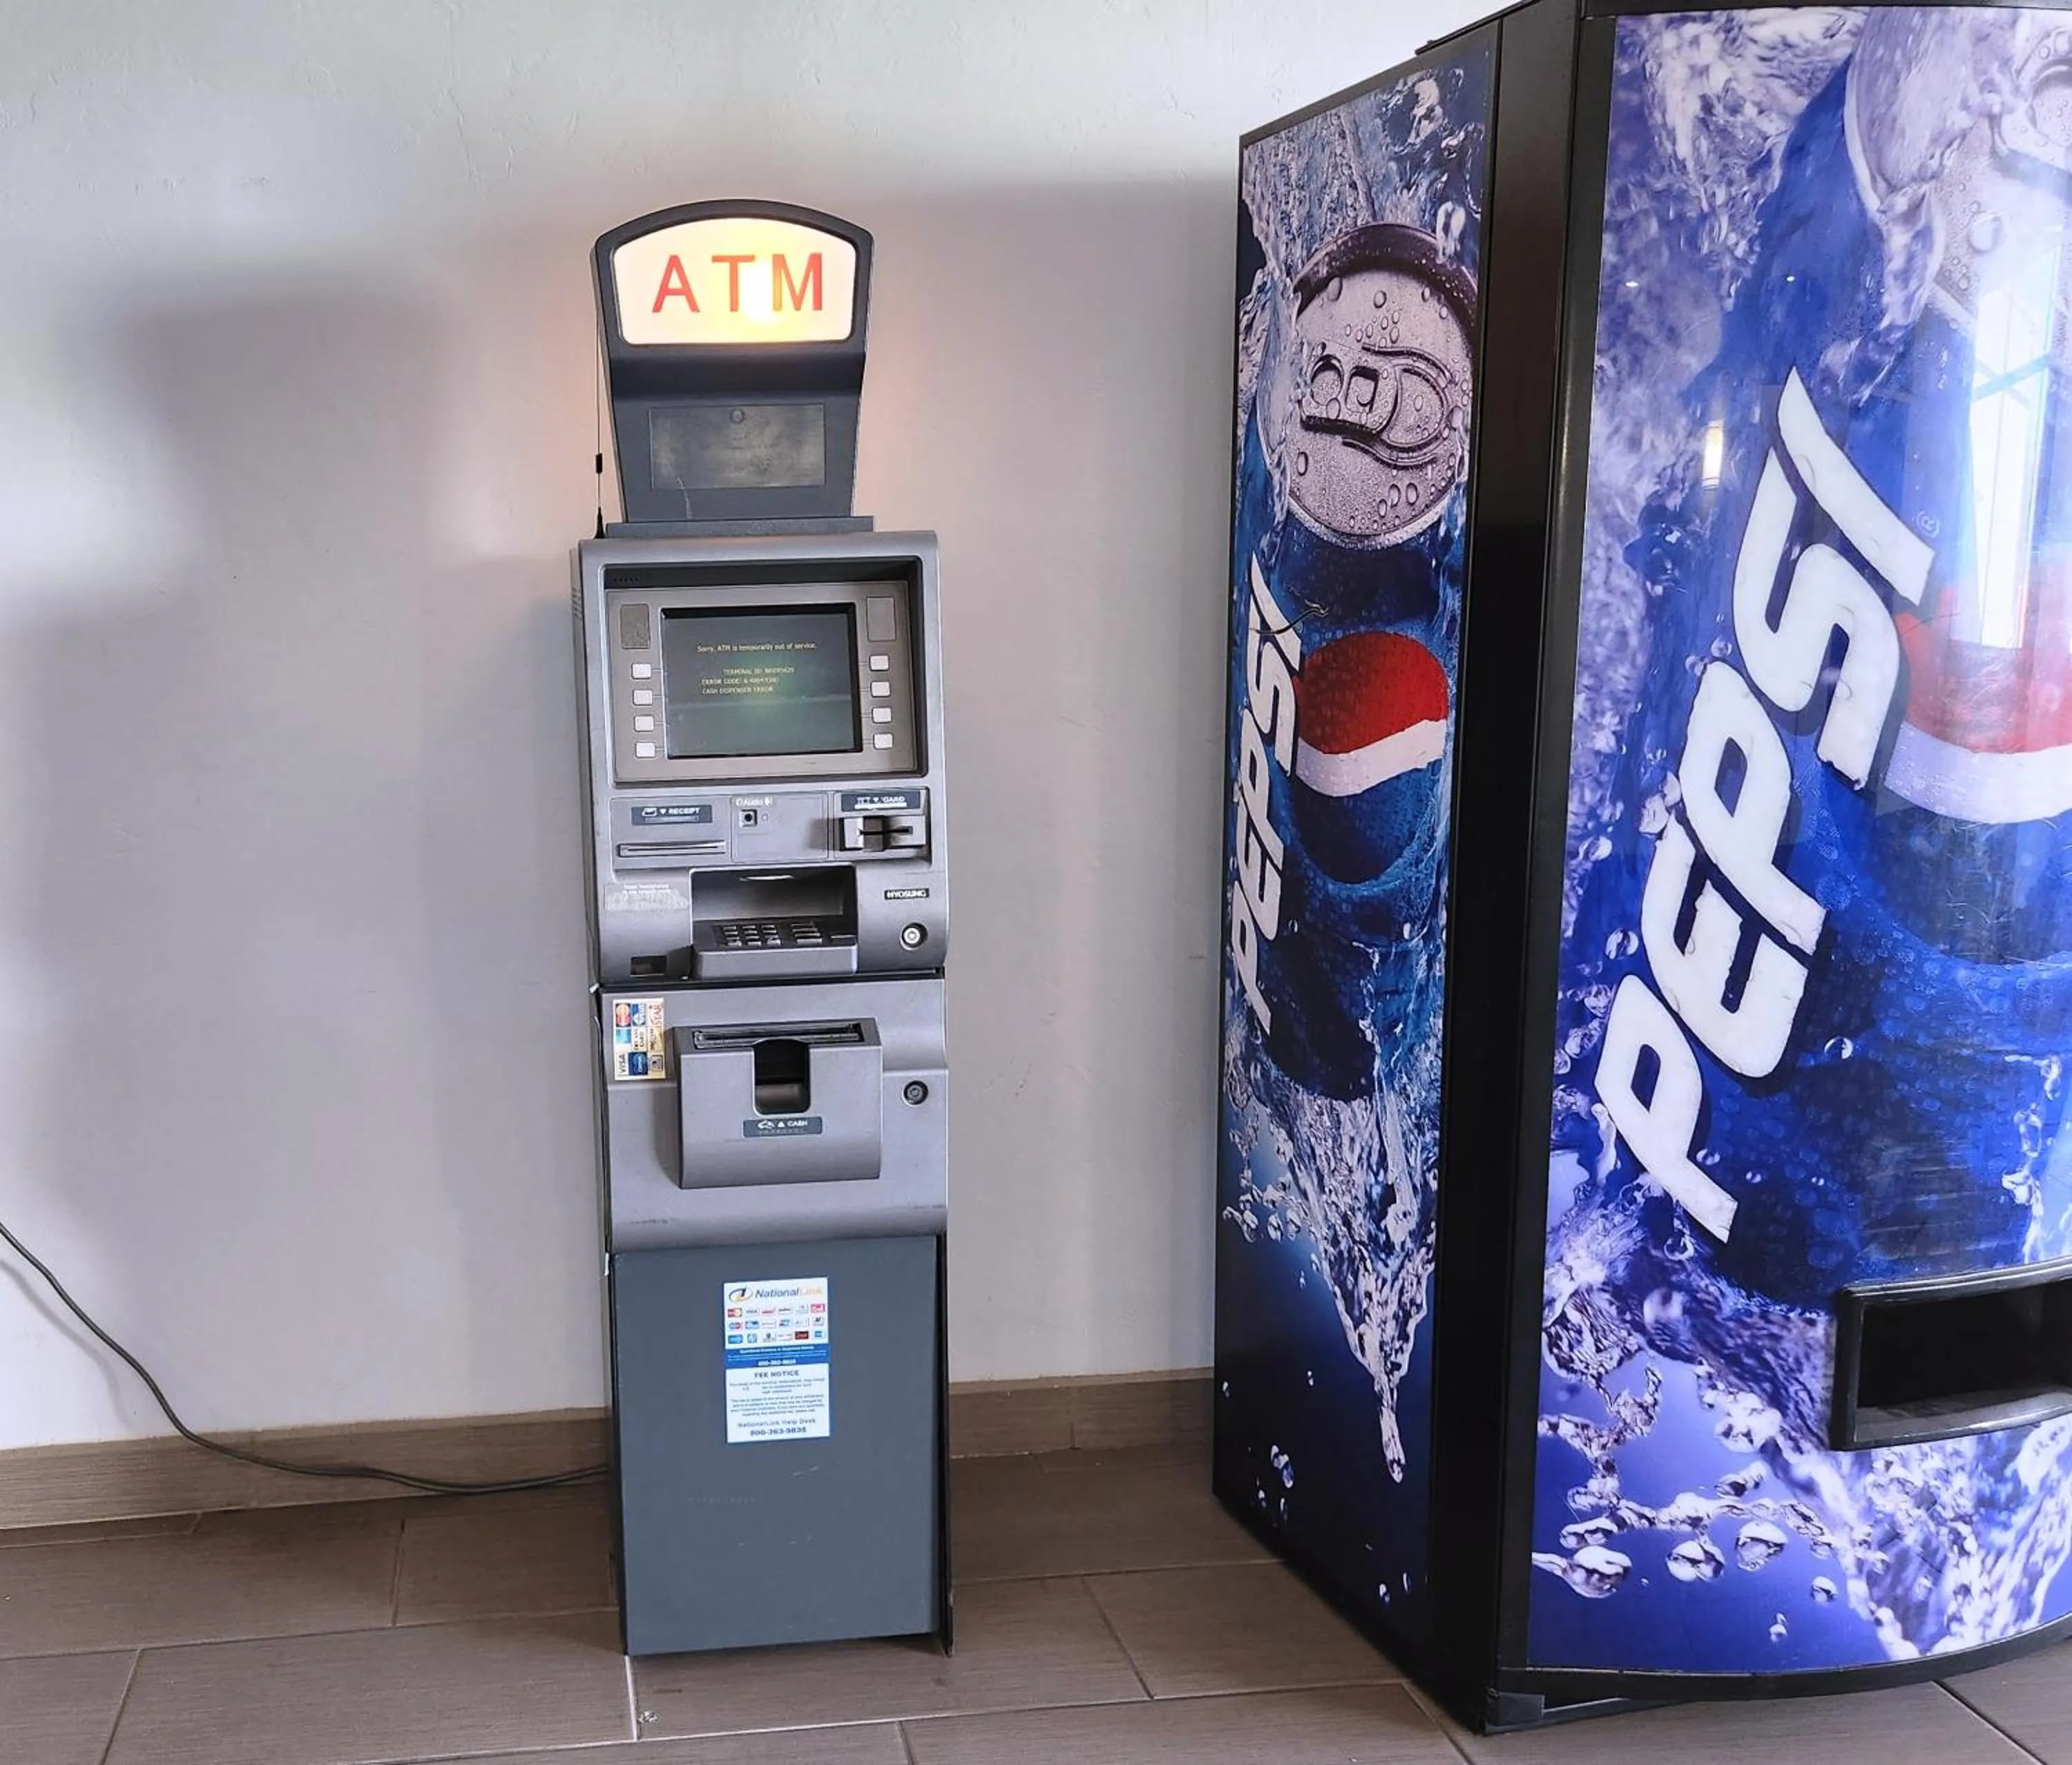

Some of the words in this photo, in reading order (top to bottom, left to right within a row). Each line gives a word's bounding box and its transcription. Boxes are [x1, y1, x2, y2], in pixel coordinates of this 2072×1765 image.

[652, 253, 824, 313] ATM
[739, 643, 773, 652] temporarily
[1231, 551, 1302, 1036] PEPSI
[1594, 366, 1935, 1244] PEPSI
[668, 807, 700, 815] RECEIPT
[887, 890, 927, 898] HYOSUNG
